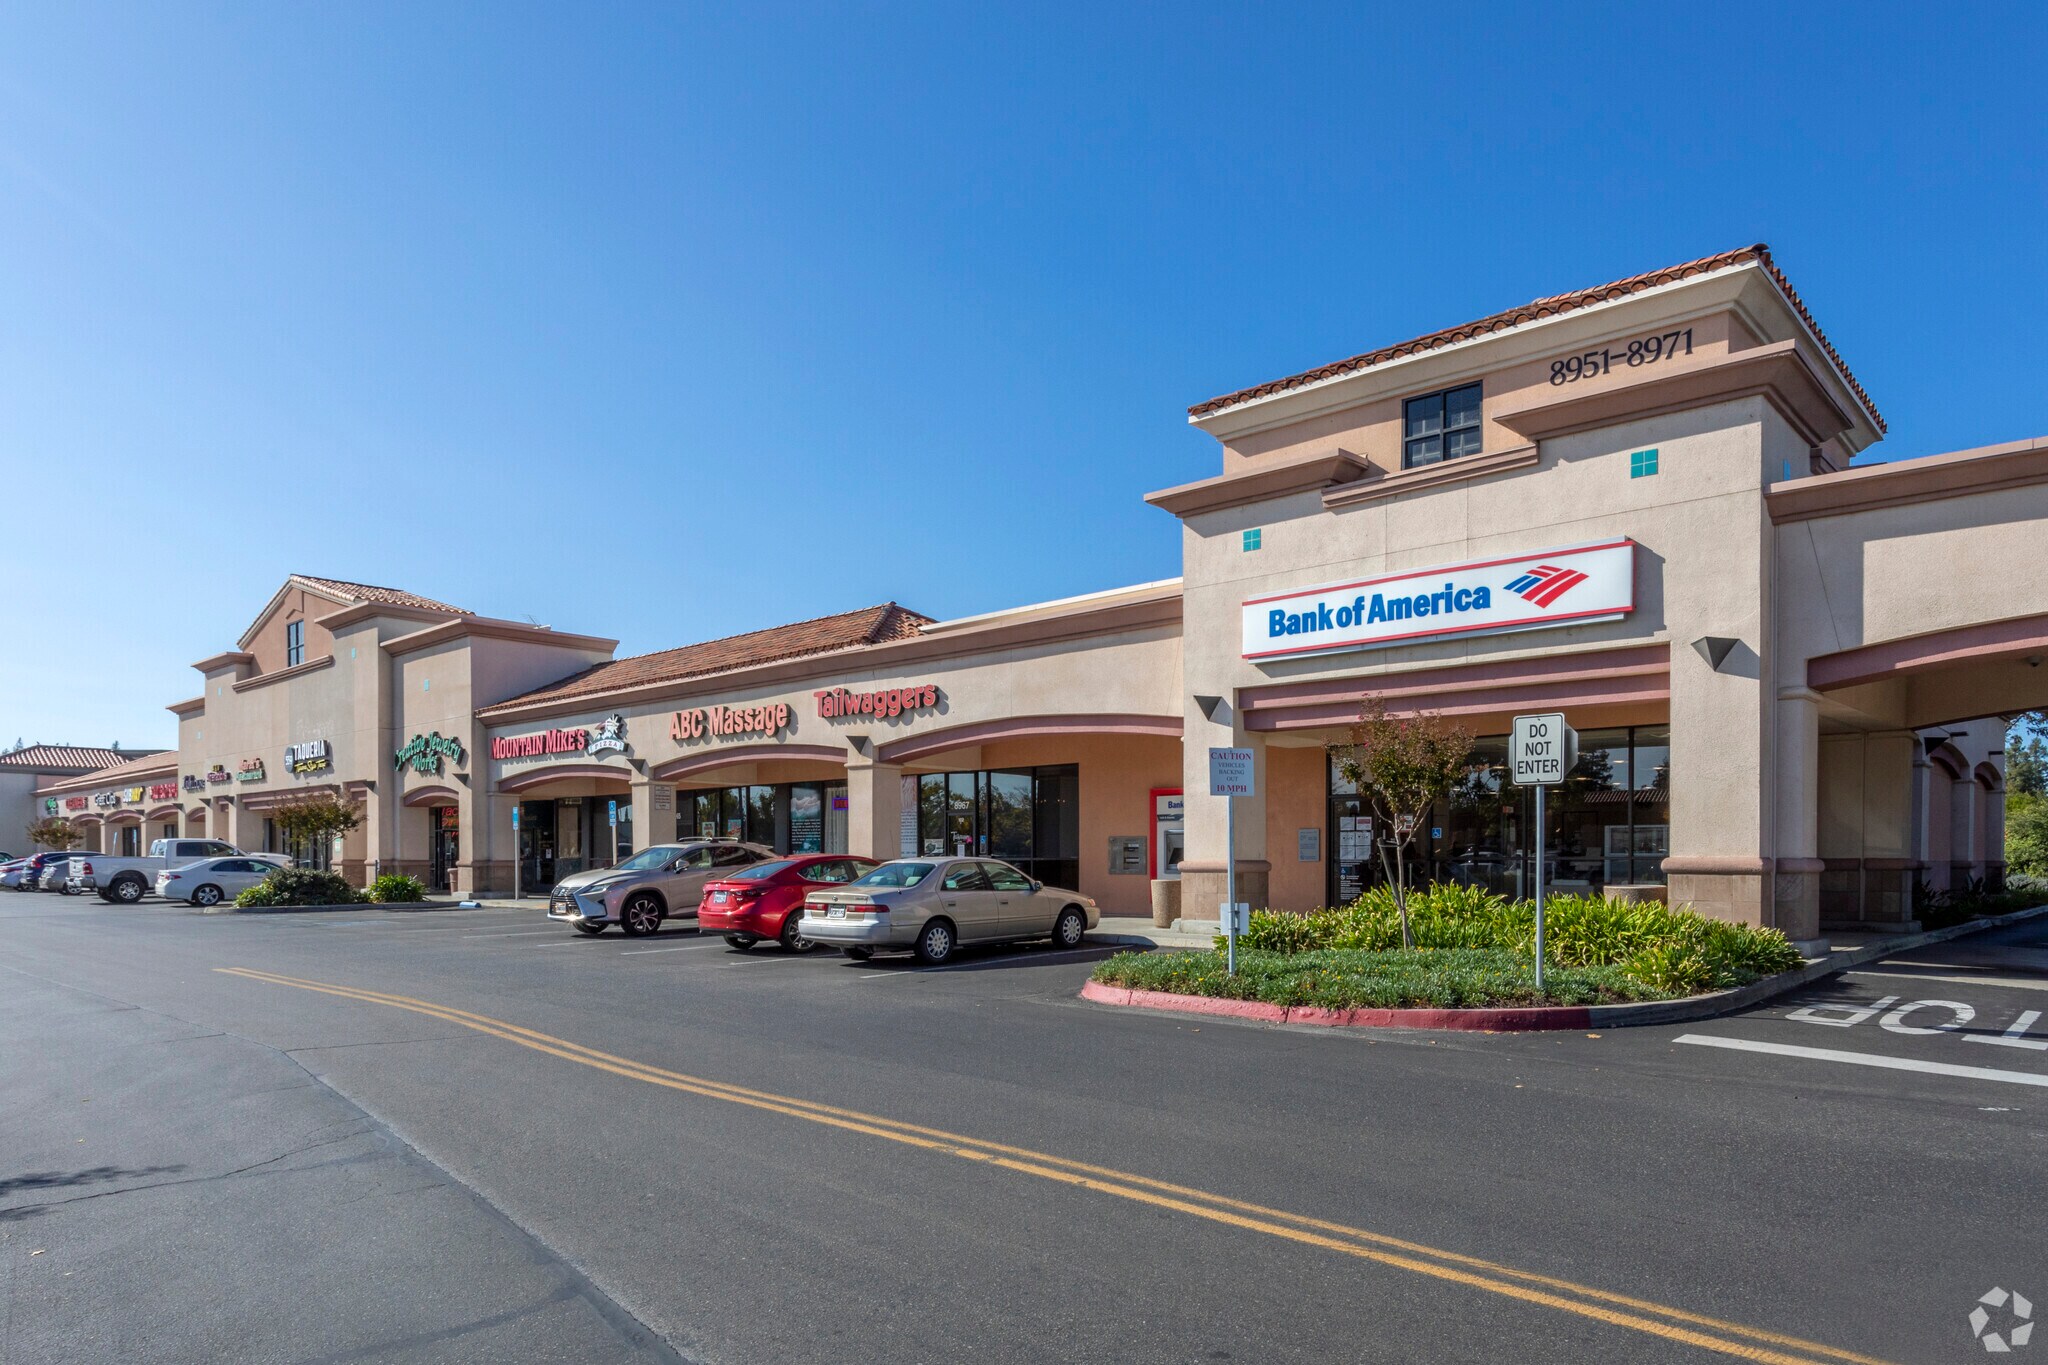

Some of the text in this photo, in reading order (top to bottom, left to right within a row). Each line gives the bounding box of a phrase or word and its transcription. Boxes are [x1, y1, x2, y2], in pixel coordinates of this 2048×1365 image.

[1549, 328, 1693, 386] 8951-8971
[1268, 583, 1491, 638] Bank of America
[813, 684, 936, 718] Tailwaggers
[669, 703, 787, 740] ABC Massage
[1529, 723, 1548, 738] DO
[293, 739, 326, 761] TAQUERIA
[426, 730, 461, 765] Jewelry
[492, 728, 586, 759] MOUNTAIN MIKE'S
[594, 740, 619, 750] PIZZA
[1525, 741, 1552, 756] NOT
[411, 751, 438, 773] Works
[1210, 751, 1252, 760] CAUTION
[1517, 759, 1559, 774] ENTER
[1216, 784, 1247, 793] 10 MPH
[954, 801, 970, 810] 8967
[1167, 800, 1184, 809] Bank
